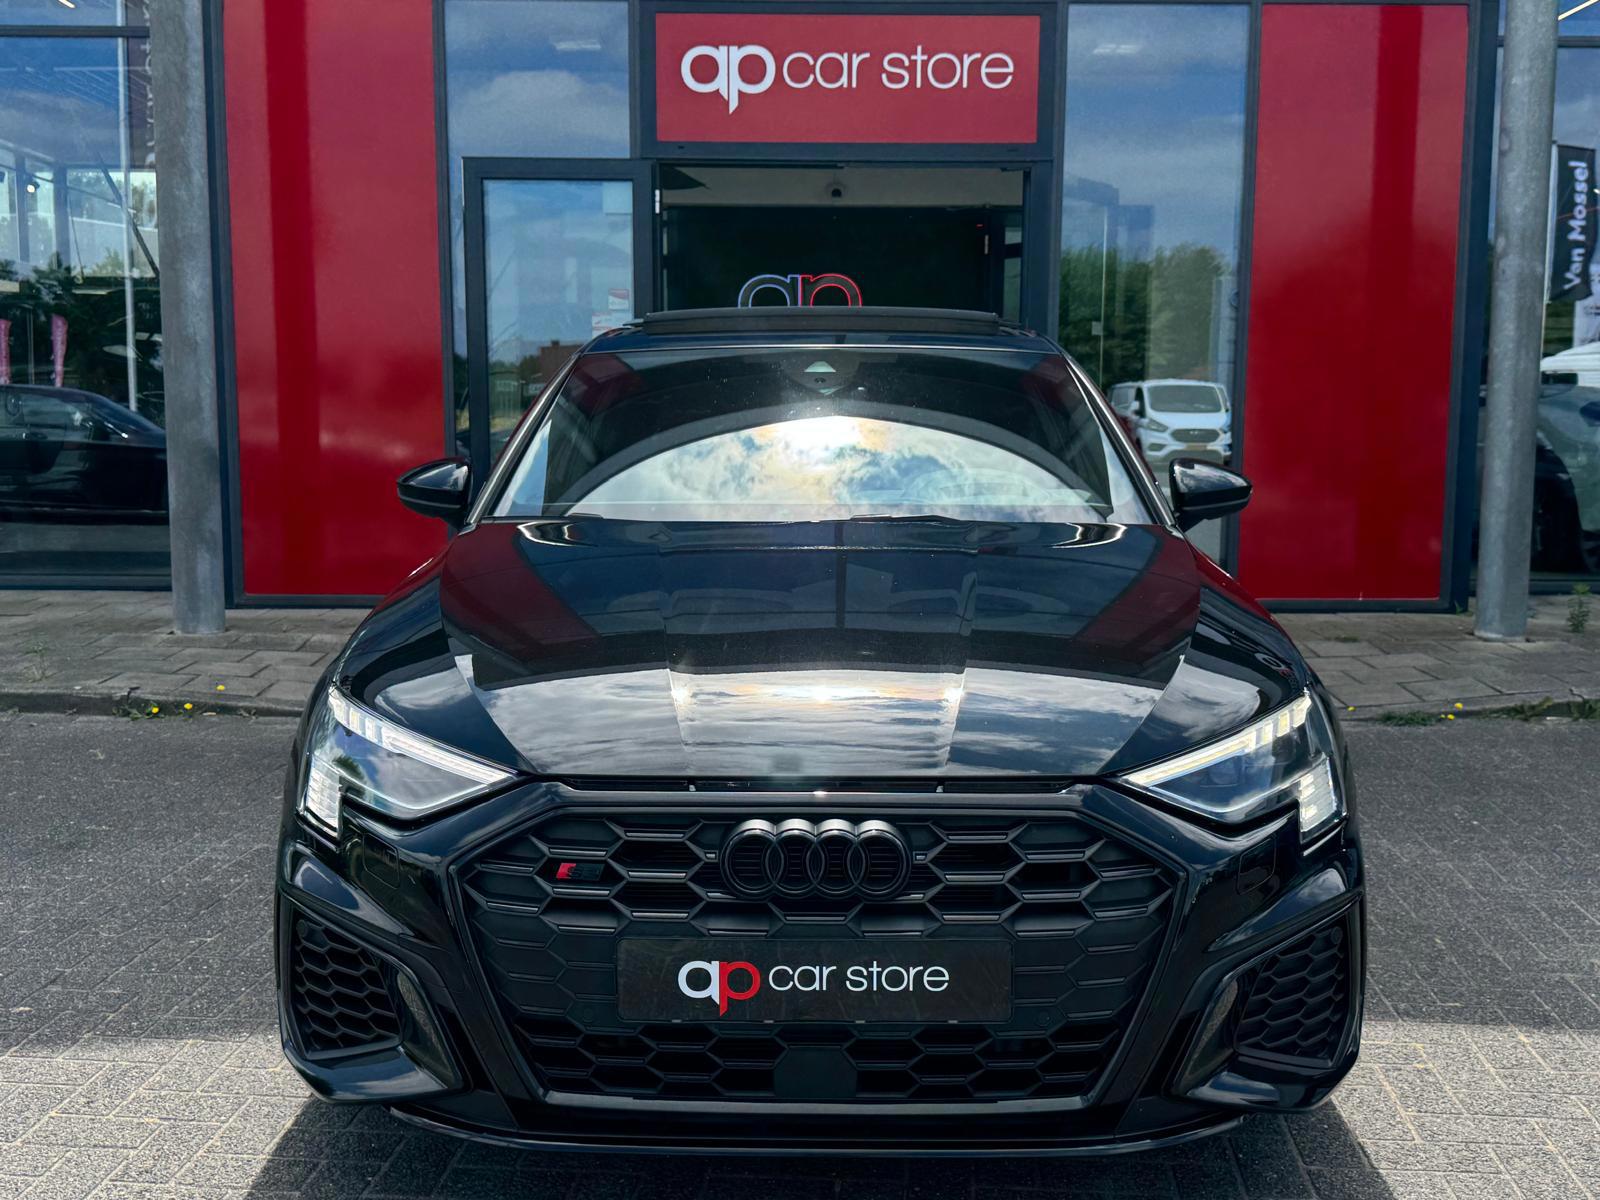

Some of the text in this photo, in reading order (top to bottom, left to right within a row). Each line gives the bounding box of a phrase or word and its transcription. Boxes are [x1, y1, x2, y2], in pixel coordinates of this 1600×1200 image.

[681, 45, 1014, 115] ap car store
[1563, 160, 1589, 290] Van Mossel
[678, 960, 950, 1017] ap car store
